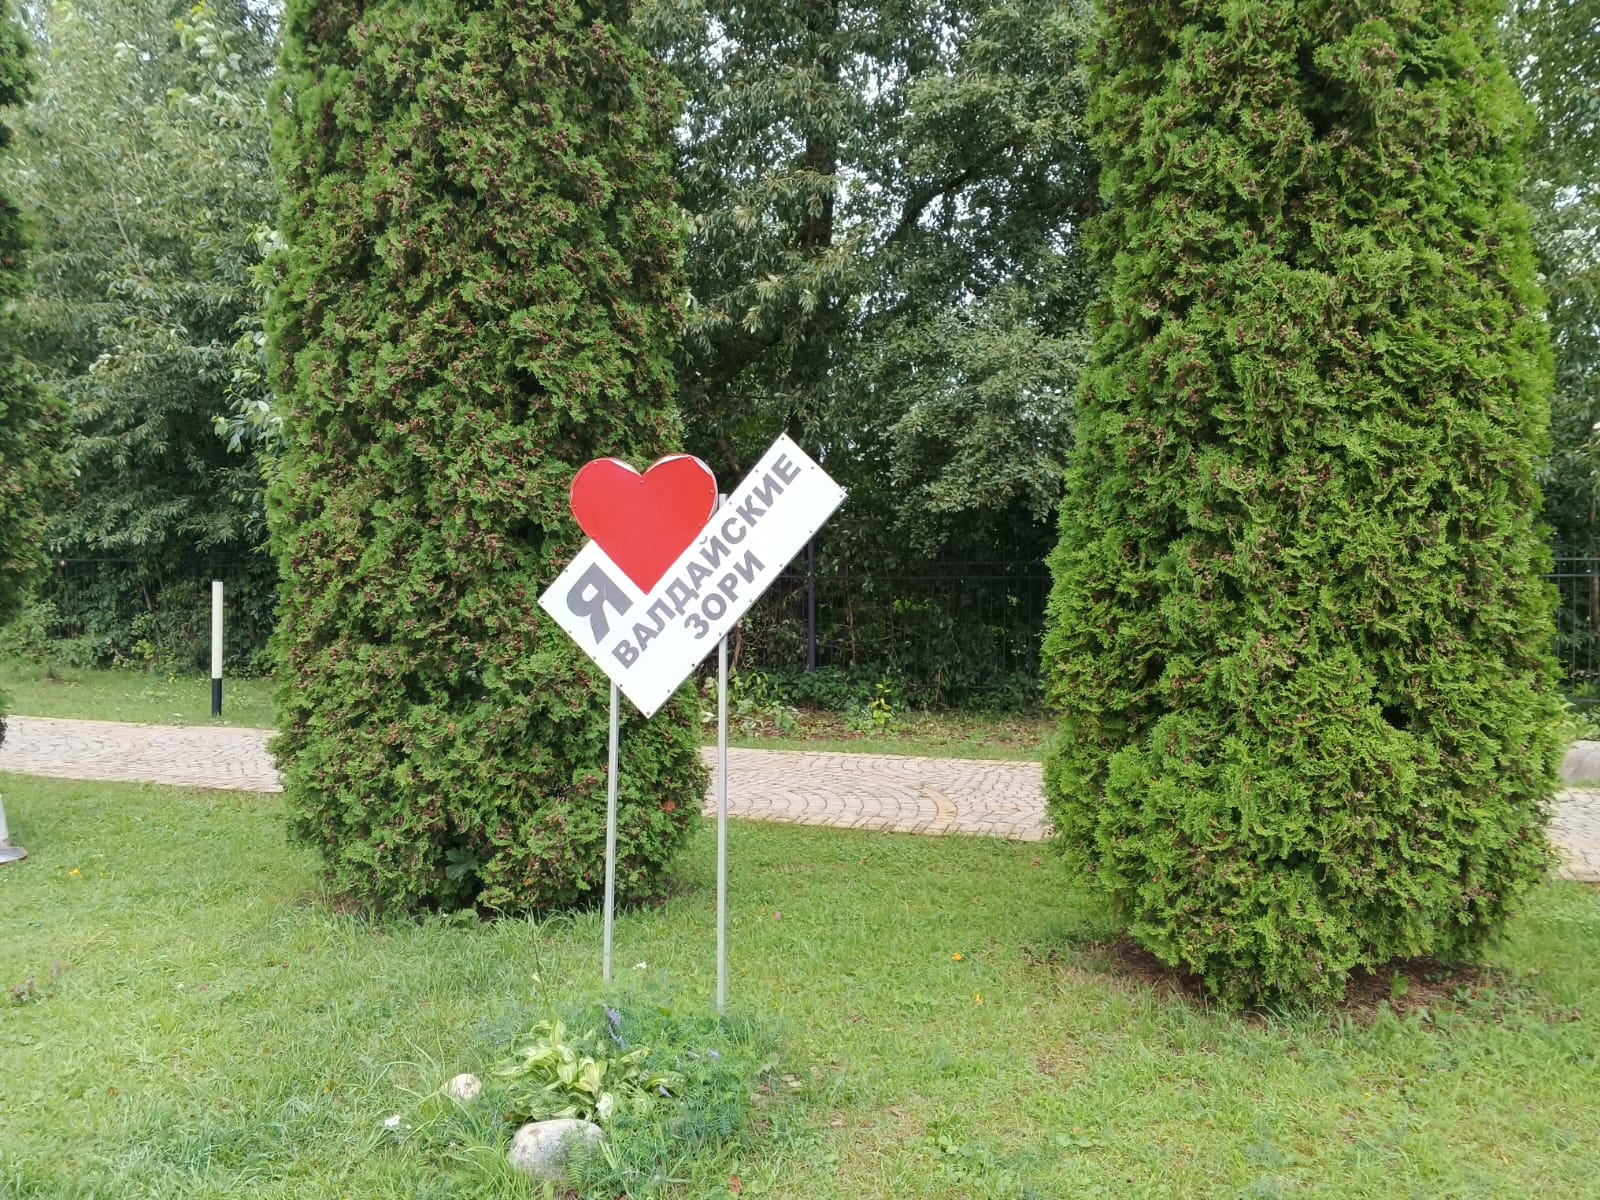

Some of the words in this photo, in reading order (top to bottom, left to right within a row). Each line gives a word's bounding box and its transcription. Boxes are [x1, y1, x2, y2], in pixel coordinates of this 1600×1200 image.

[566, 562, 634, 645] Я
[611, 453, 802, 669] ВАЛДАЙСКИЕ
[683, 549, 766, 640] ЗОРИ
